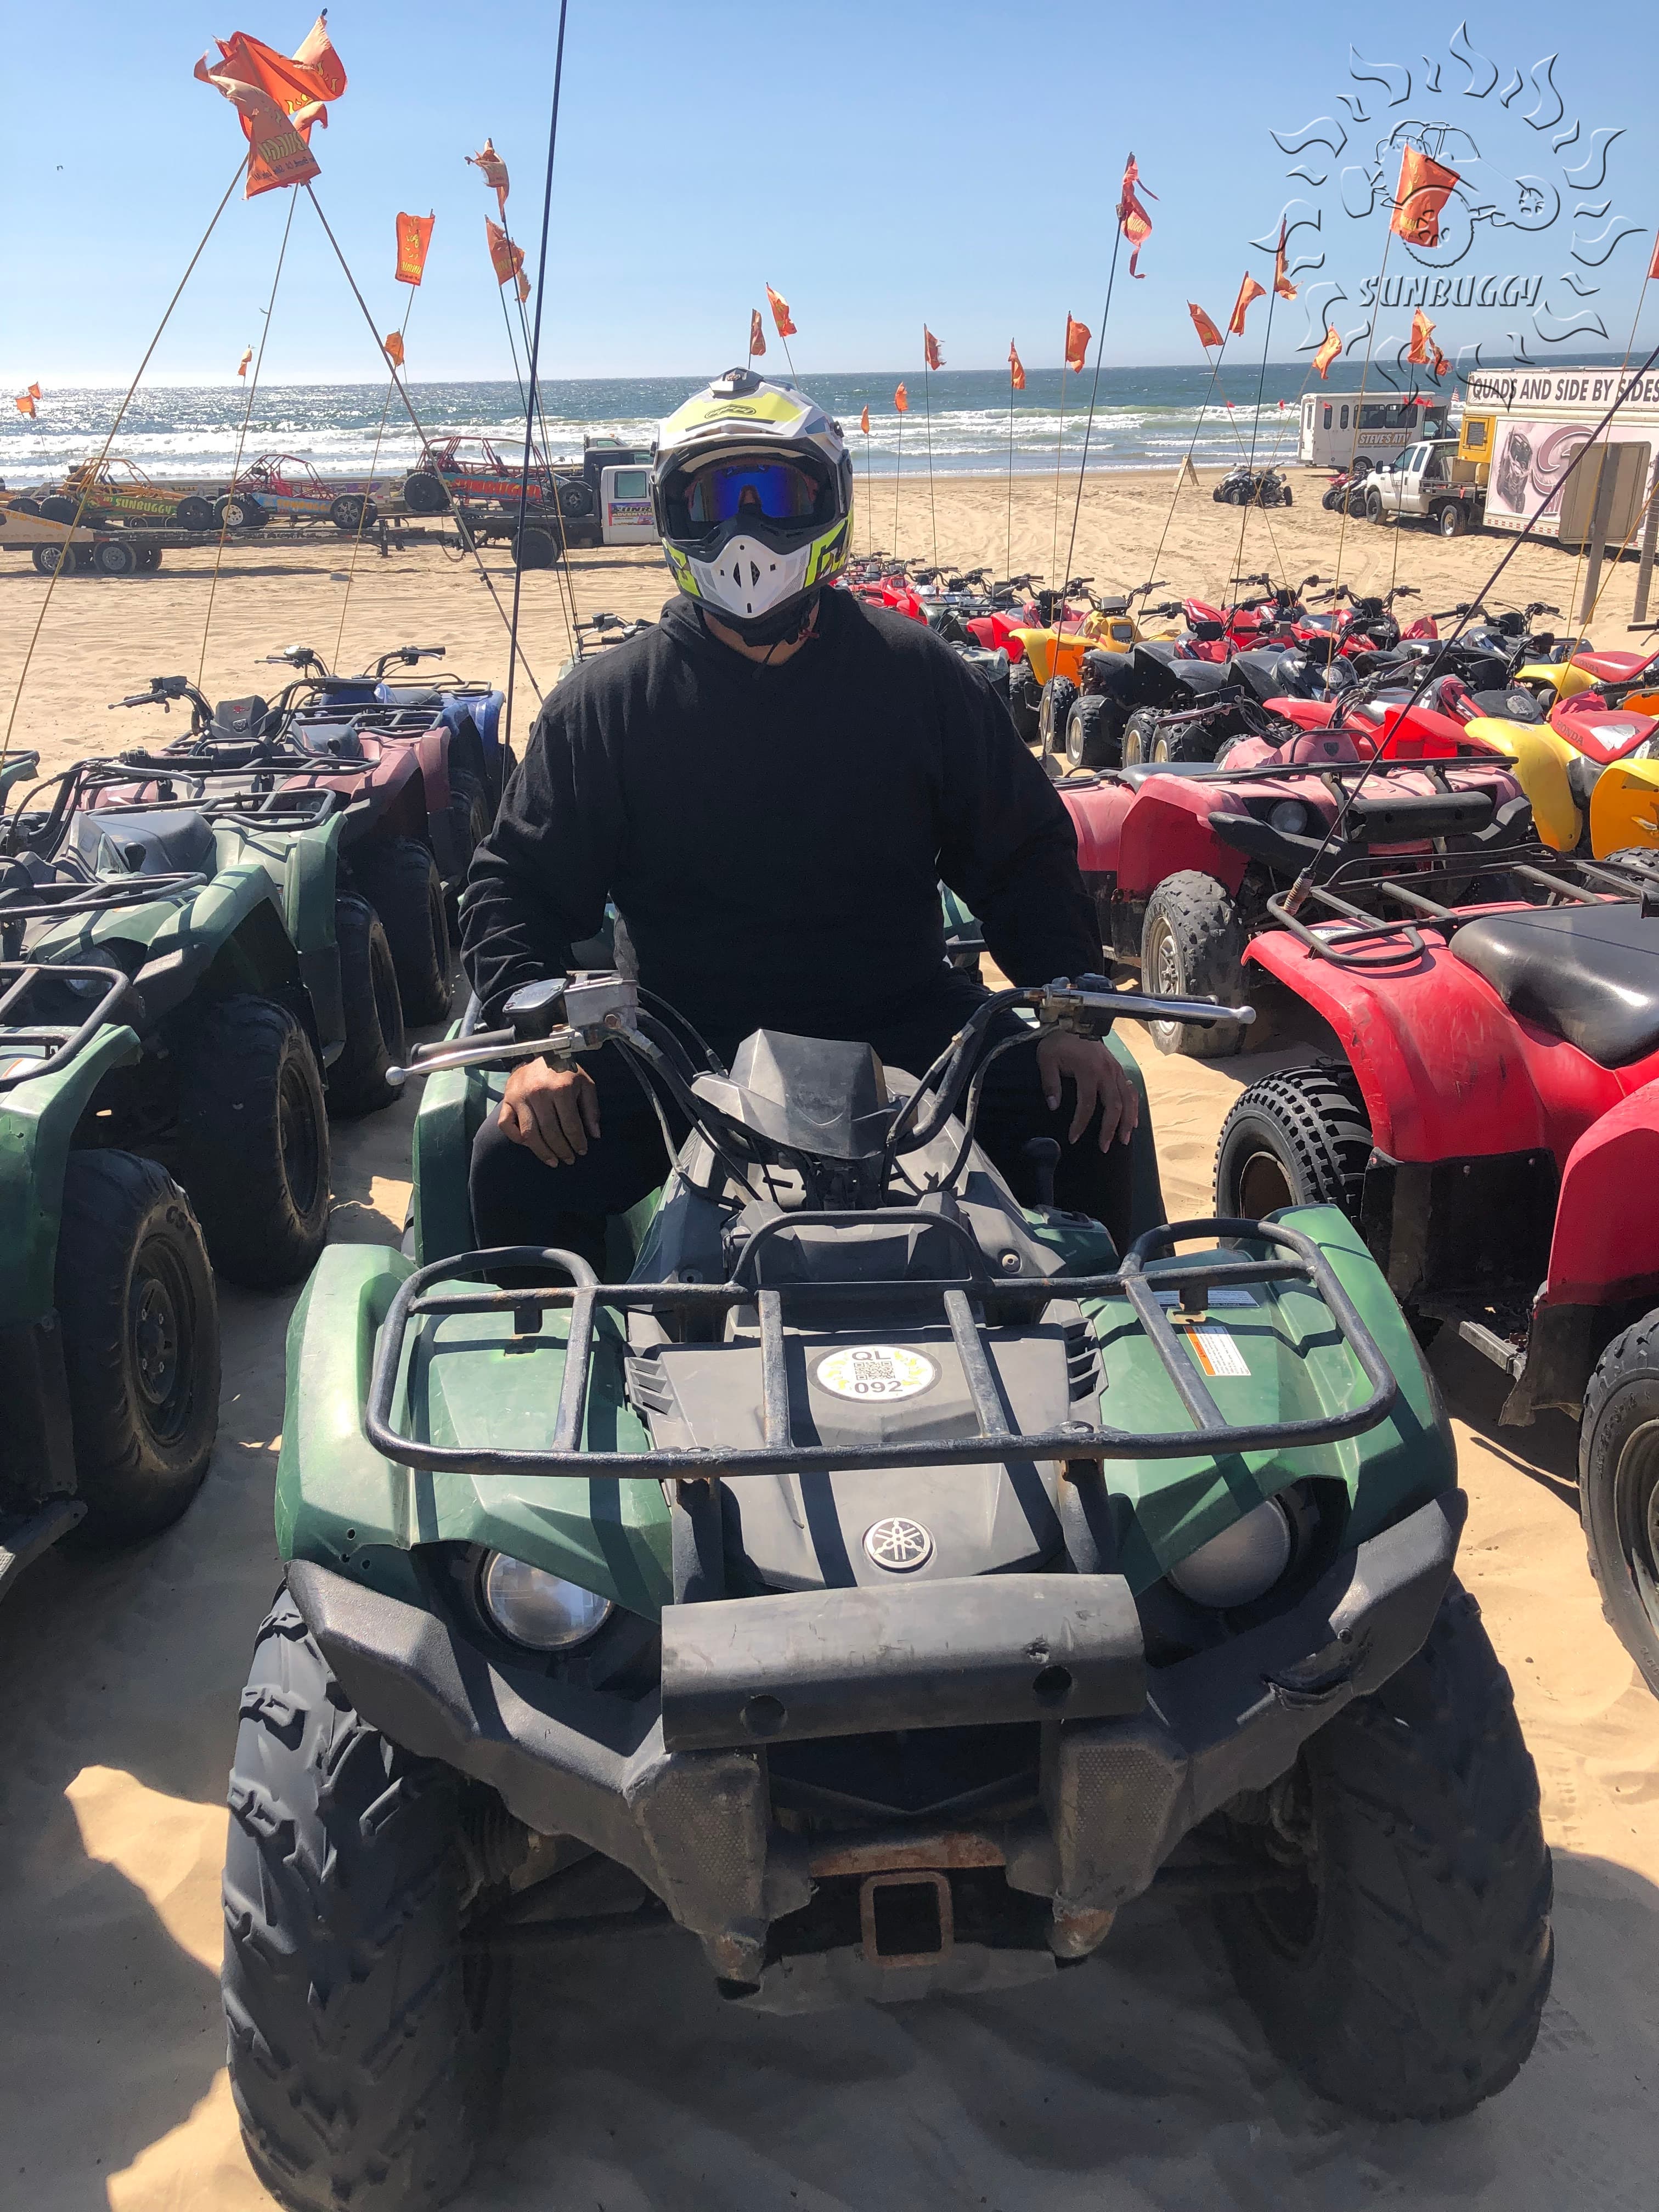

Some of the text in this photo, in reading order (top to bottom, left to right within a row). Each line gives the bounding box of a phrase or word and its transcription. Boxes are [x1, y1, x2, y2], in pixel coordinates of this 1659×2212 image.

[1473, 379, 1517, 400] QUADS
[1520, 379, 1551, 400] AND
[1555, 379, 1588, 402] SIDE
[1592, 379, 1615, 402] BY
[115, 498, 172, 515] SUNBUGGY
[1556, 720, 1584, 746] HONDA
[852, 1351, 891, 1361] QL
[854, 1381, 903, 1393] 092
